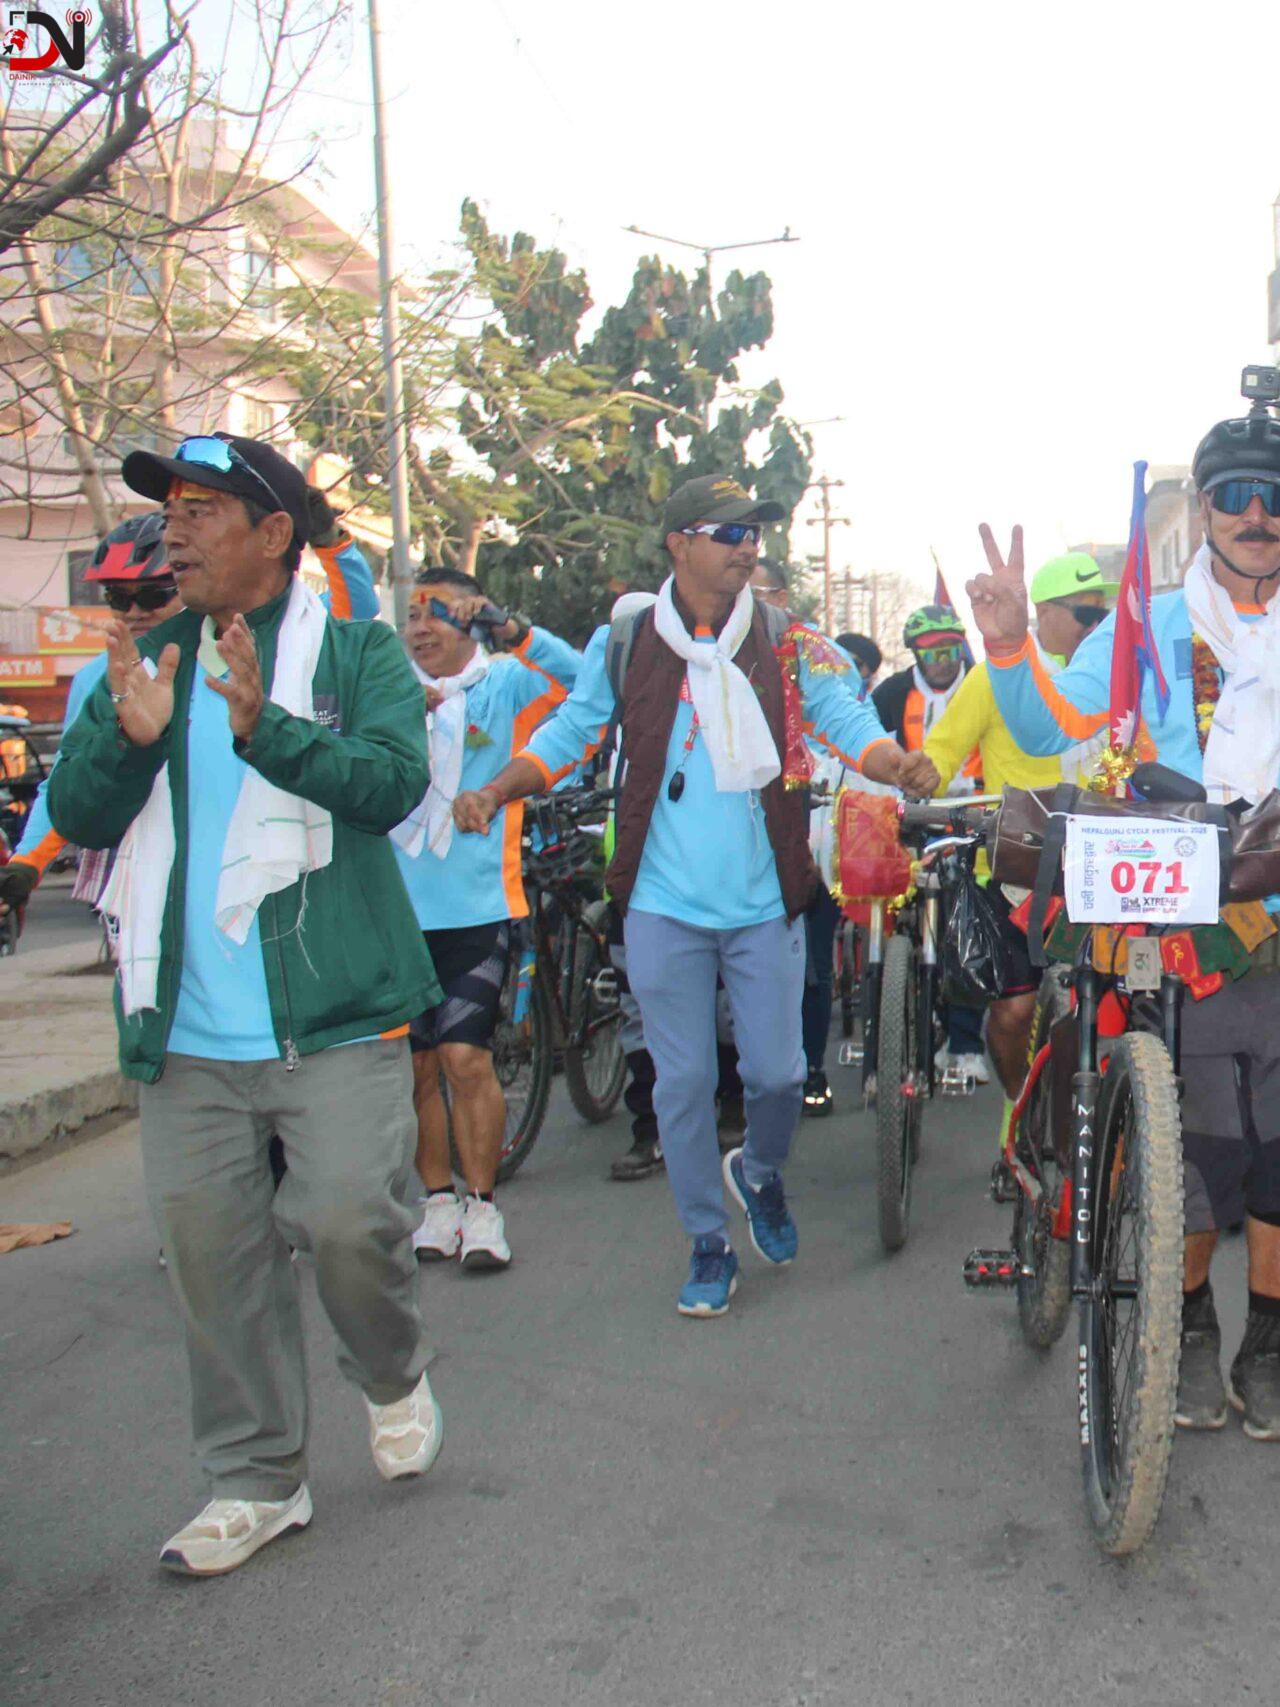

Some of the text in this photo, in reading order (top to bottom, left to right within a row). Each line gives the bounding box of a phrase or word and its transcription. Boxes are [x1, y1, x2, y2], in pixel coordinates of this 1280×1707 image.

[1110, 861, 1190, 894] 071
[1077, 1103, 1095, 1244] MANITOU
[1079, 1344, 1090, 1445] MAXXIS
